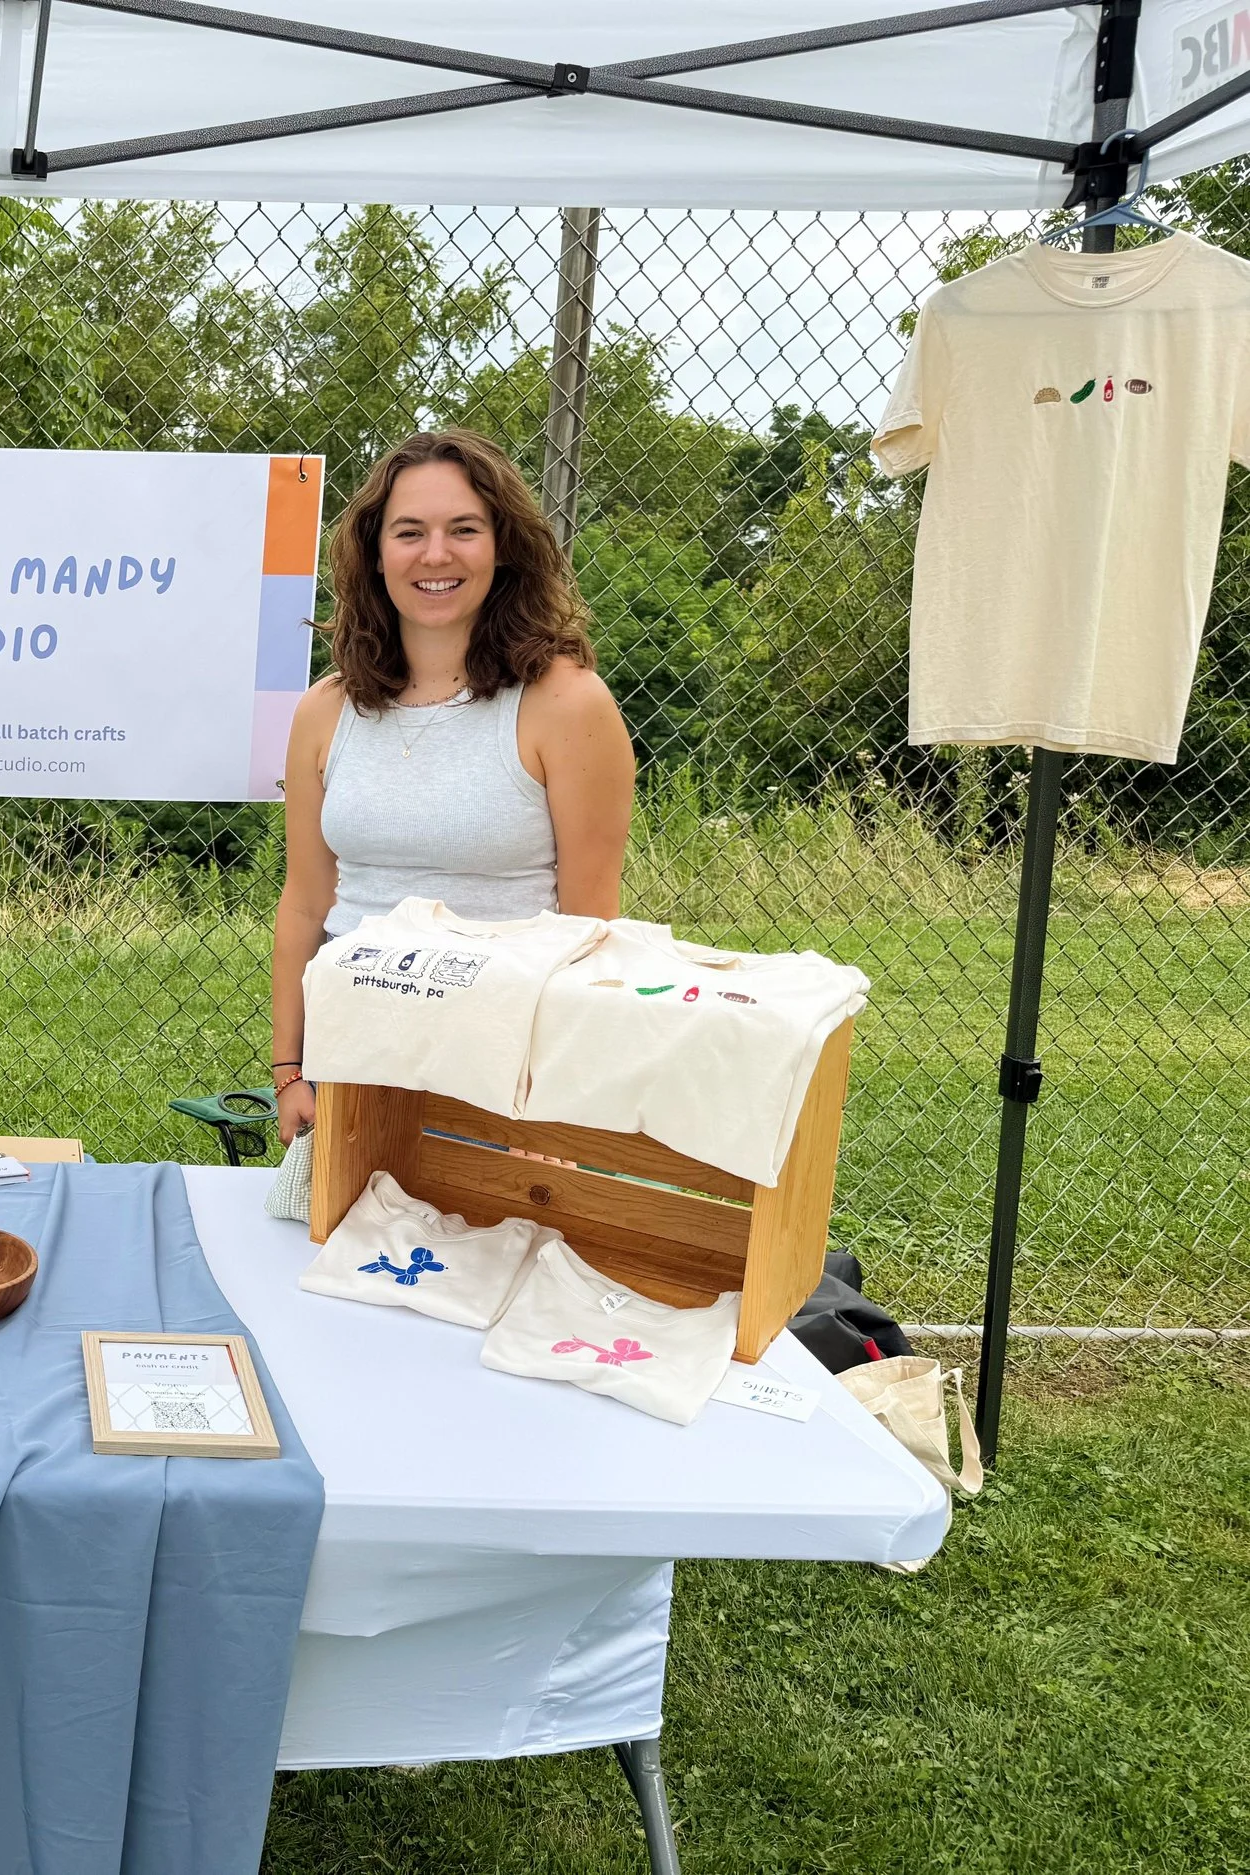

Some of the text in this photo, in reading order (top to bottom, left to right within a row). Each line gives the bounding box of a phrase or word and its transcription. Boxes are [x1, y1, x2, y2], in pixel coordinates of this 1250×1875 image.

[10, 555, 176, 597] MANDY
[17, 724, 69, 740] batch
[74, 726, 126, 741] crafts
[353, 974, 444, 998] pittsburgh, pa
[121, 1352, 209, 1361] PAYMENTS
[741, 1381, 803, 1402] SHIRTS
